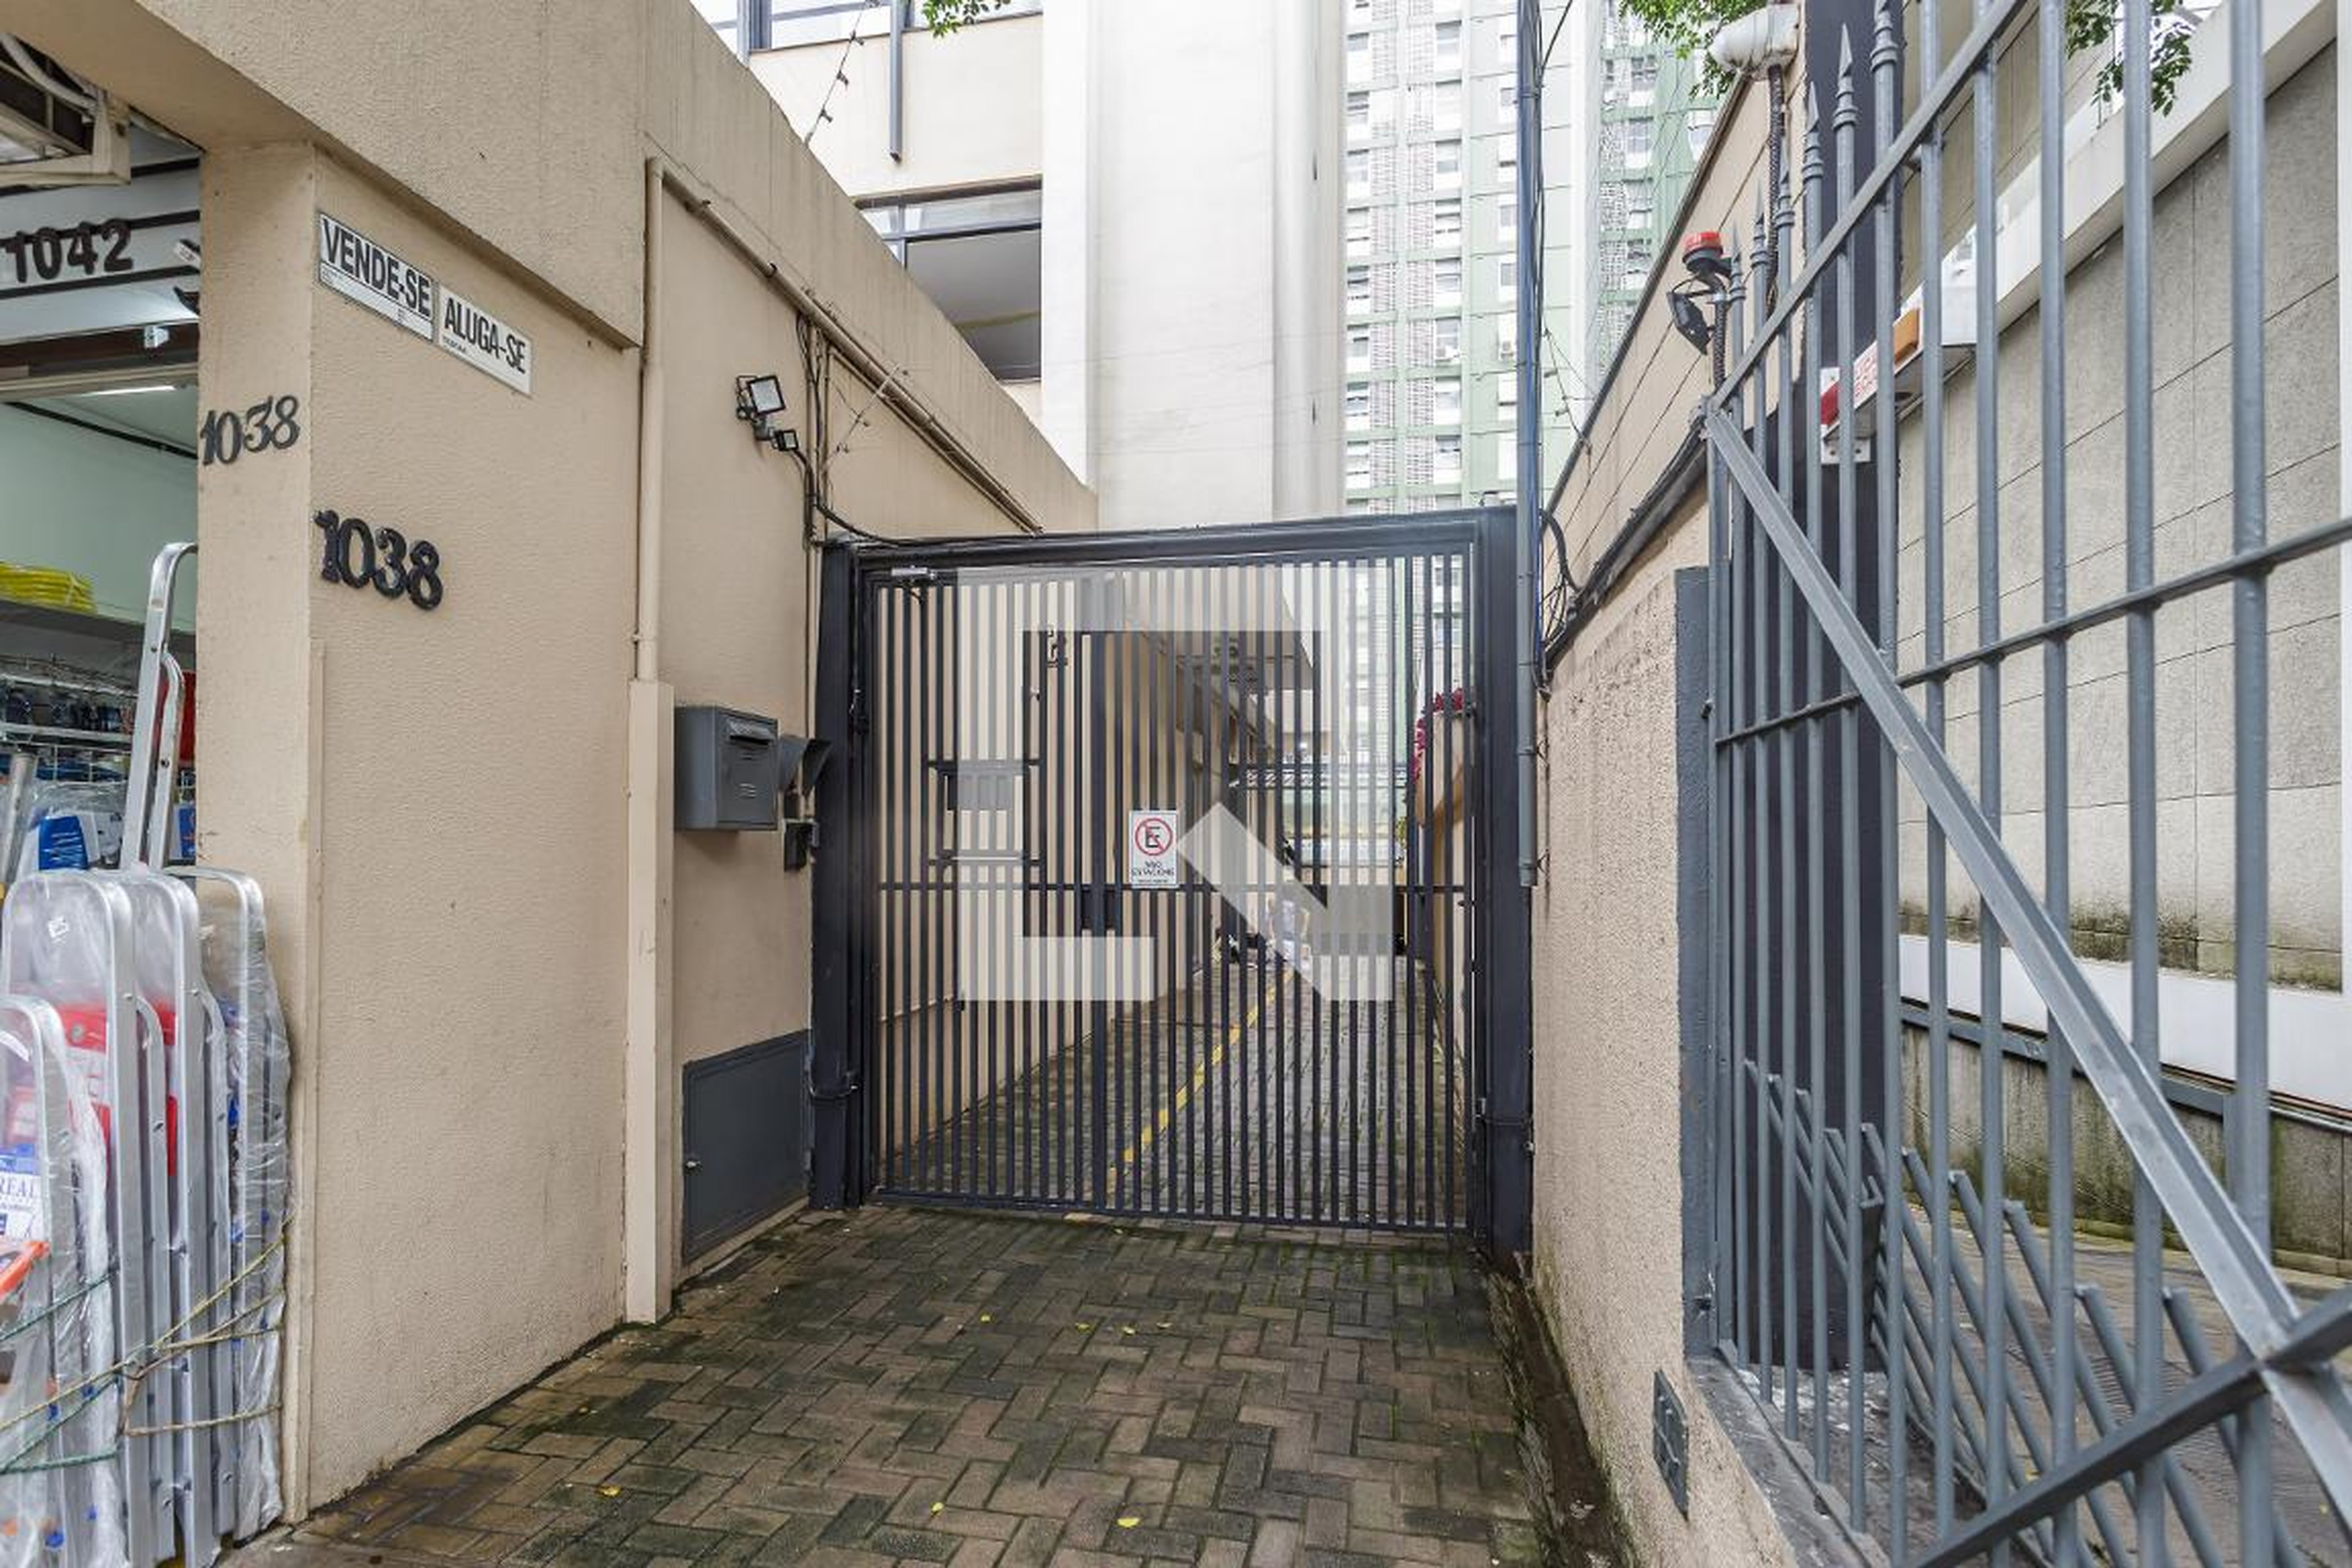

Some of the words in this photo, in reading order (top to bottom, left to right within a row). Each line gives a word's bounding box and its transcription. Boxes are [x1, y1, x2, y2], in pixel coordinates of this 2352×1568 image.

[5, 217, 133, 284] 1042
[322, 217, 431, 317] VENDE-SE
[445, 296, 526, 374] ALUGA-SE
[200, 395, 301, 466] 1038
[313, 509, 443, 611] 1038
